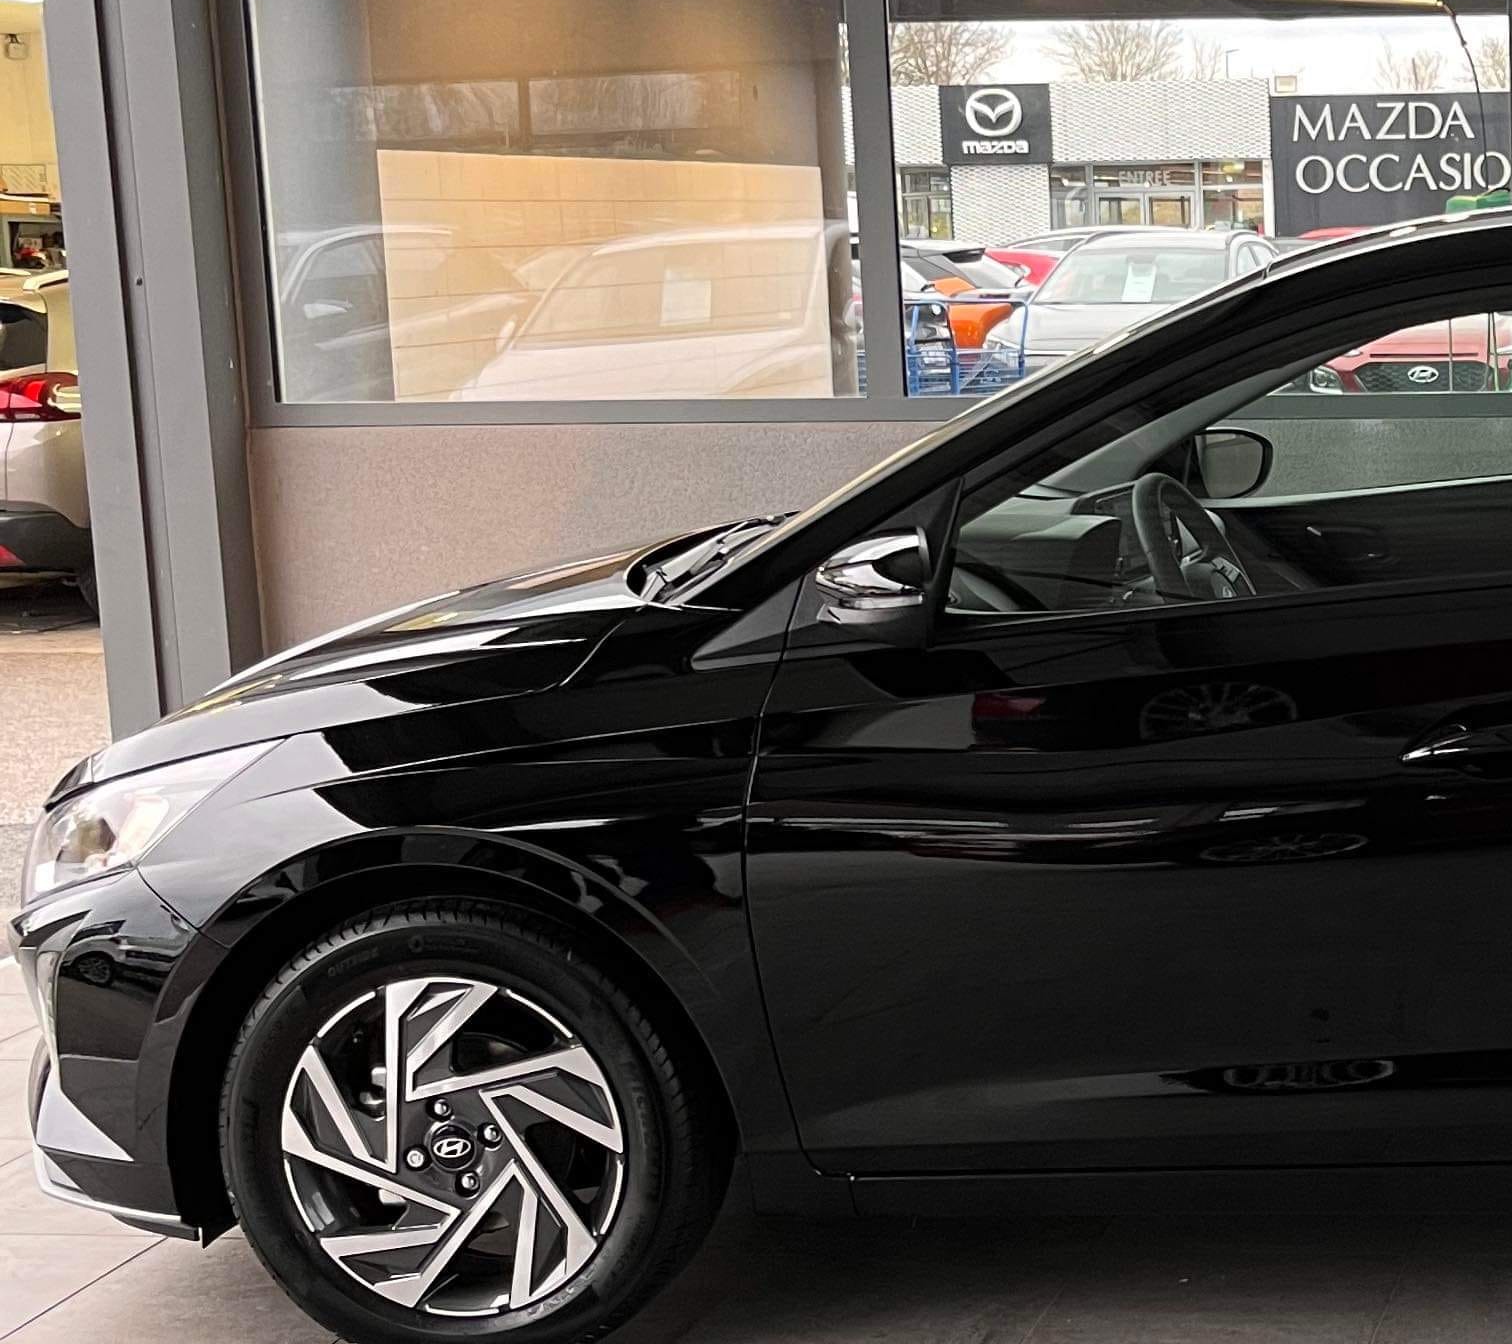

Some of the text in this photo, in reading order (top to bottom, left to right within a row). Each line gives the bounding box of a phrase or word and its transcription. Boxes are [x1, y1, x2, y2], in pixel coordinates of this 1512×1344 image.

[1292, 101, 1475, 142] MAZDA
[962, 140, 1029, 154] mazda
[1295, 151, 1512, 194] OCCASIO
